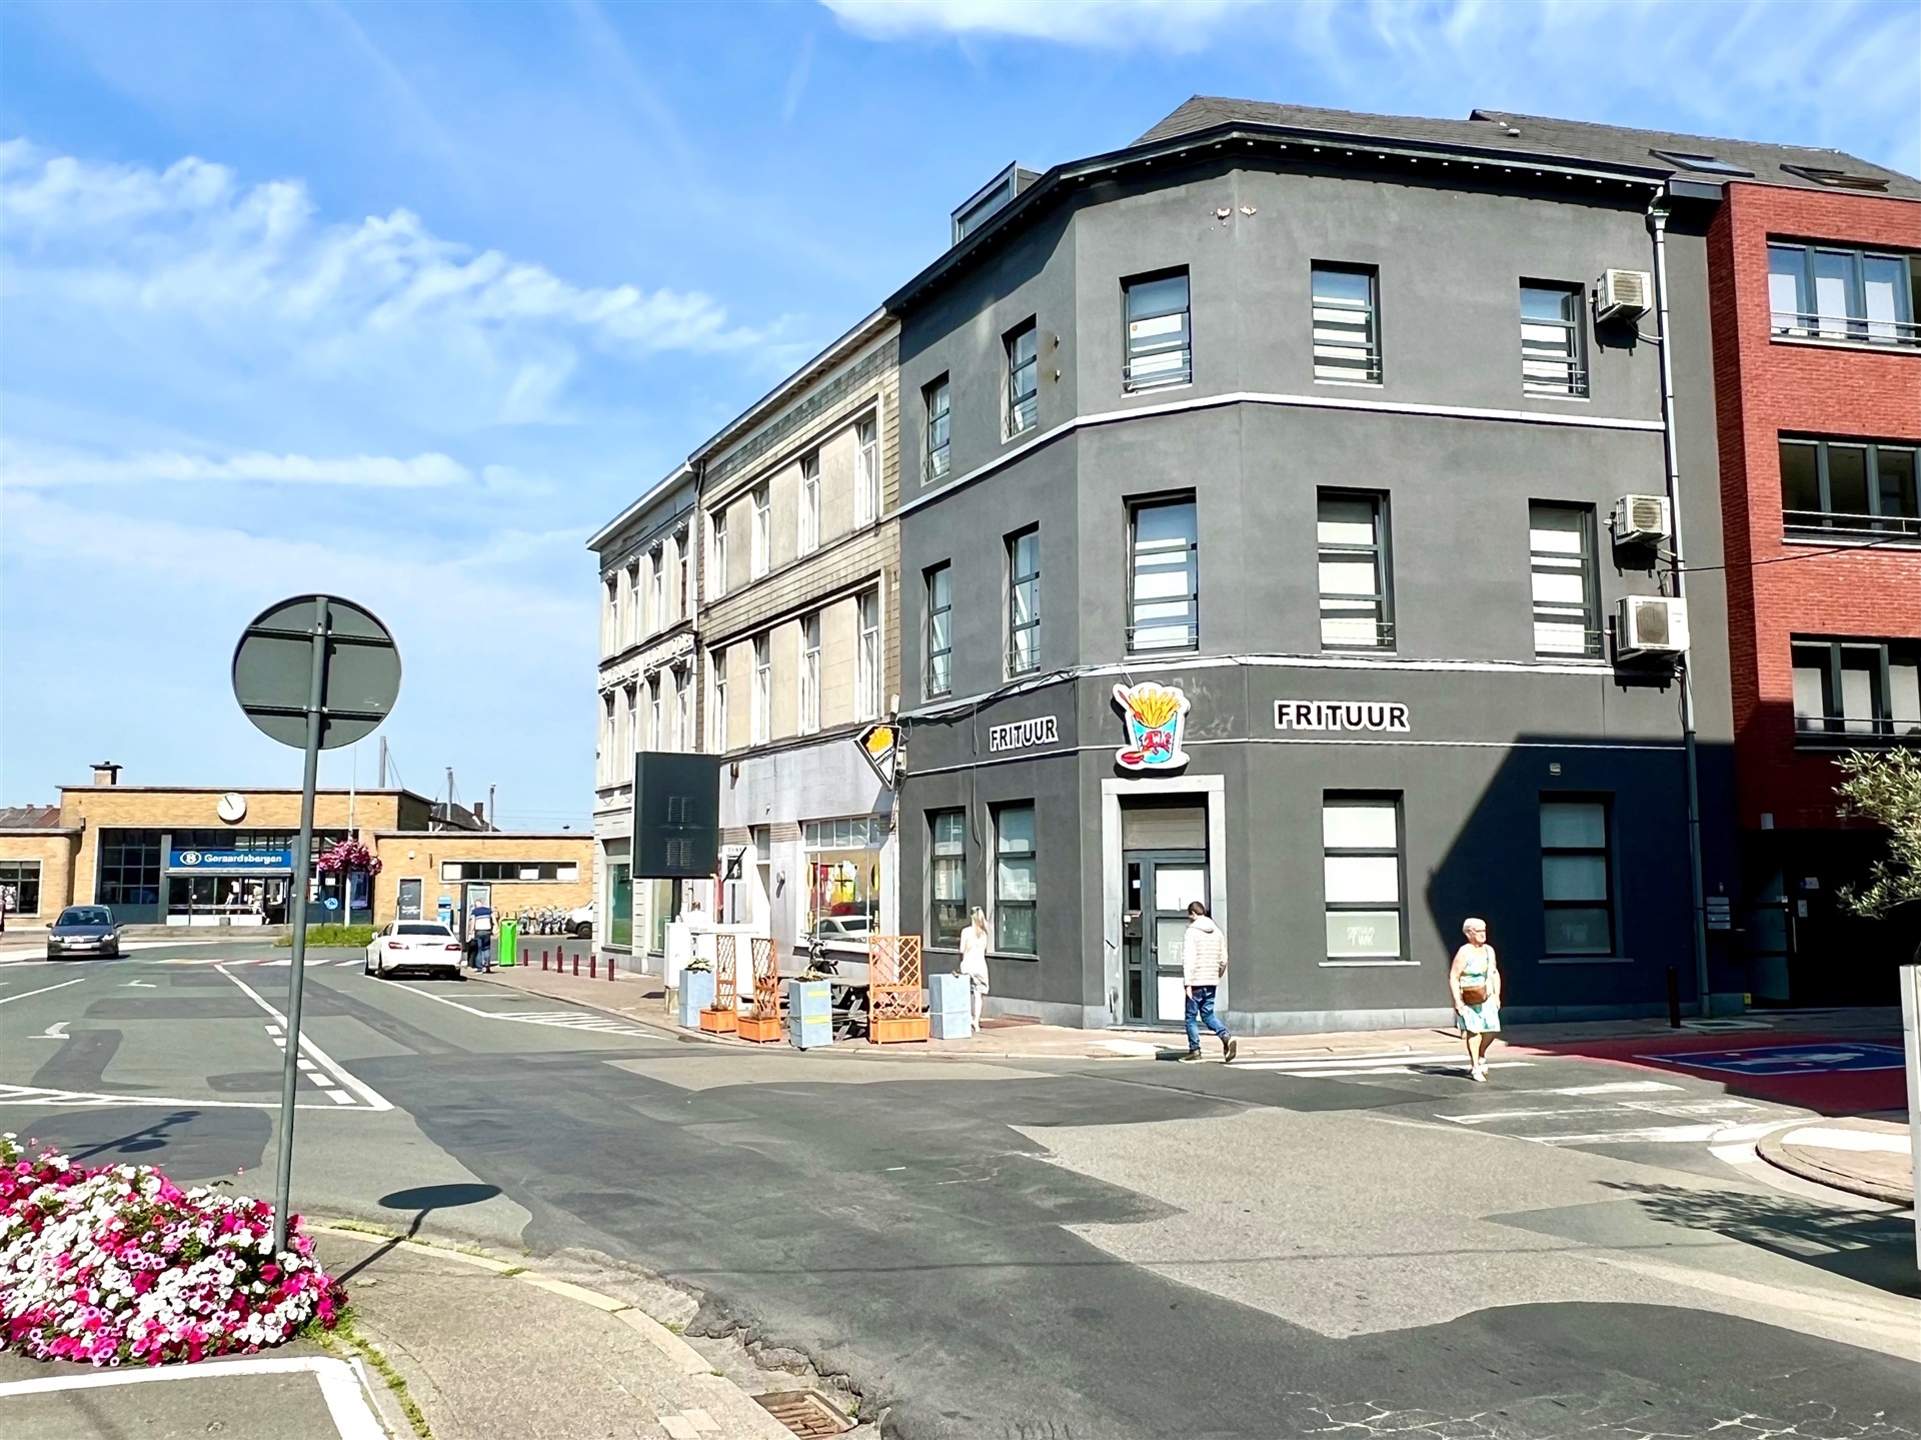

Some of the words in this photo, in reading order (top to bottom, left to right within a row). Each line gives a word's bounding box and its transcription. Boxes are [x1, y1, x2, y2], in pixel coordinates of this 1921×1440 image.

[1277, 703, 1407, 728] FRITUUR
[991, 718, 1056, 749] FRITUUR
[204, 853, 282, 864] Geraardsbergen
